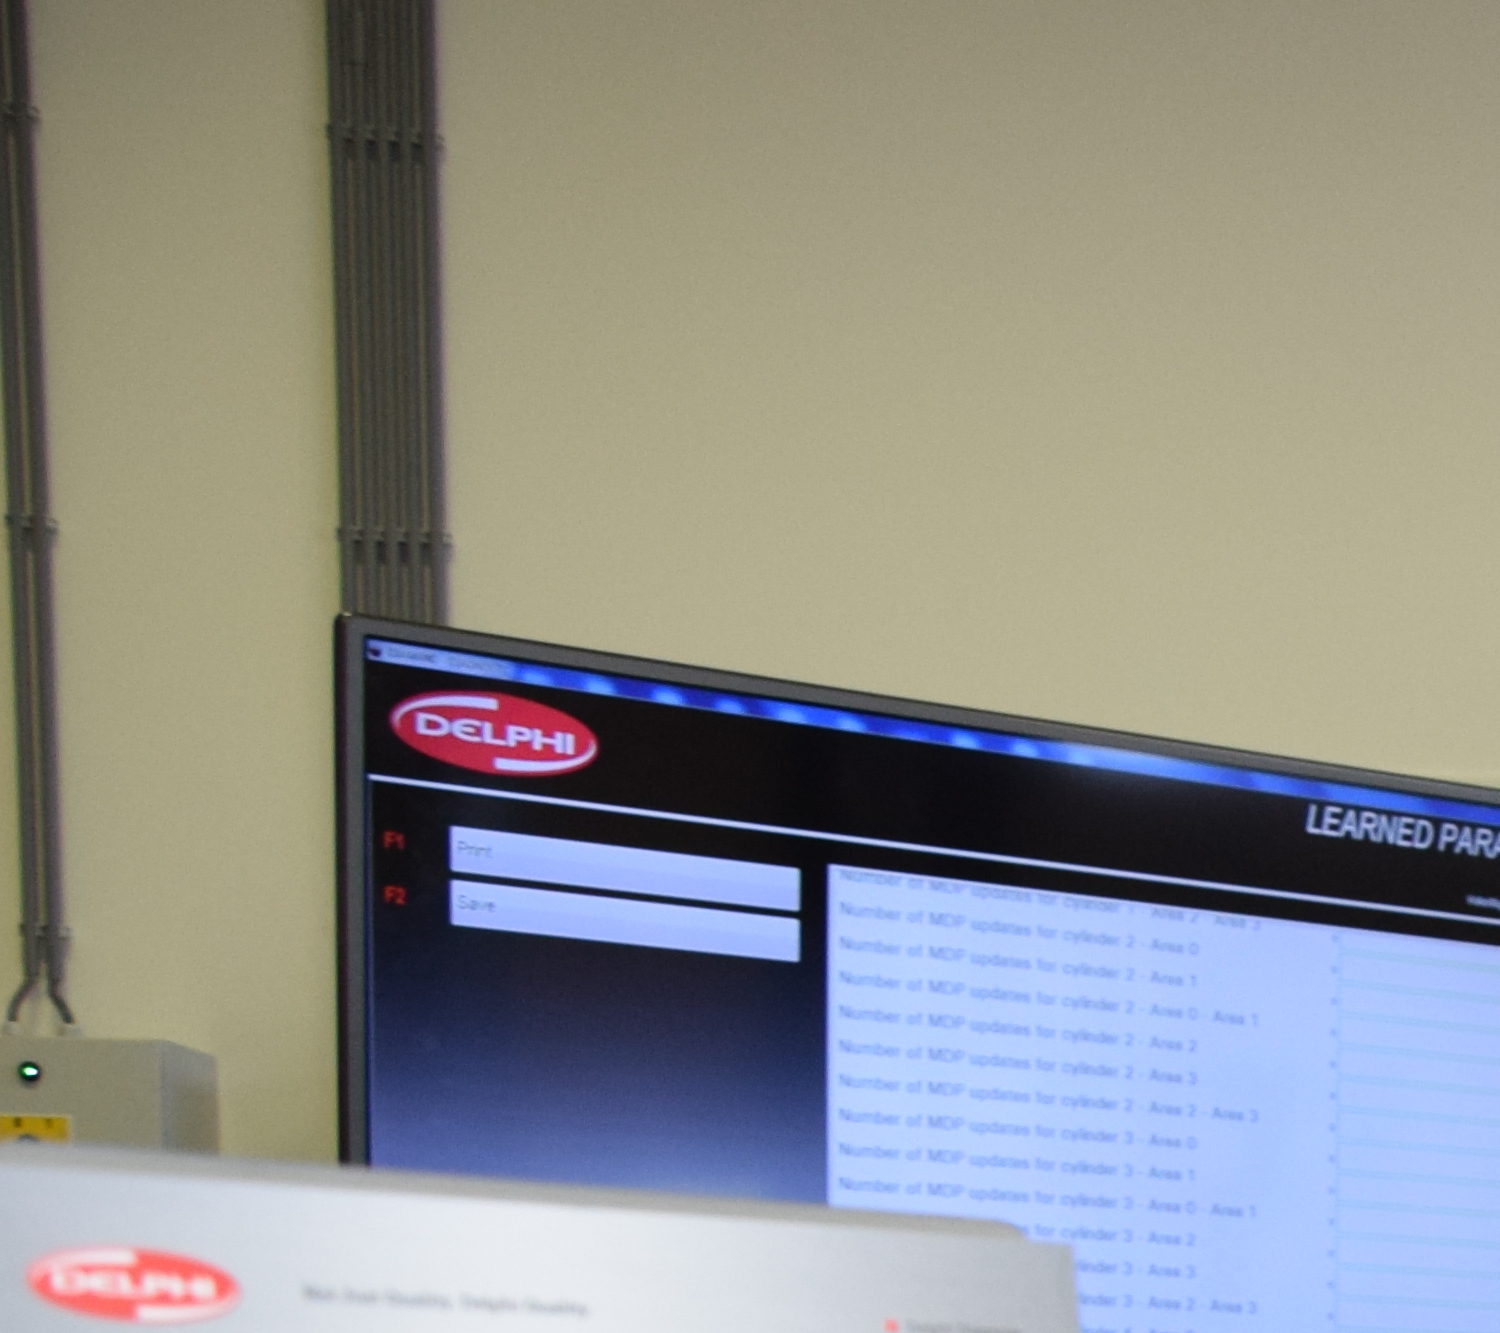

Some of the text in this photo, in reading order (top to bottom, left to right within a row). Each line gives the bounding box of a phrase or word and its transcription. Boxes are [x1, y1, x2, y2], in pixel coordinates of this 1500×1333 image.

[414, 711, 577, 756] DELPHI
[383, 830, 493, 859] F1 Print
[1305, 803, 1434, 850] LEARNED
[383, 885, 496, 913] F2 Save
[50, 1265, 218, 1303] DELPHI
